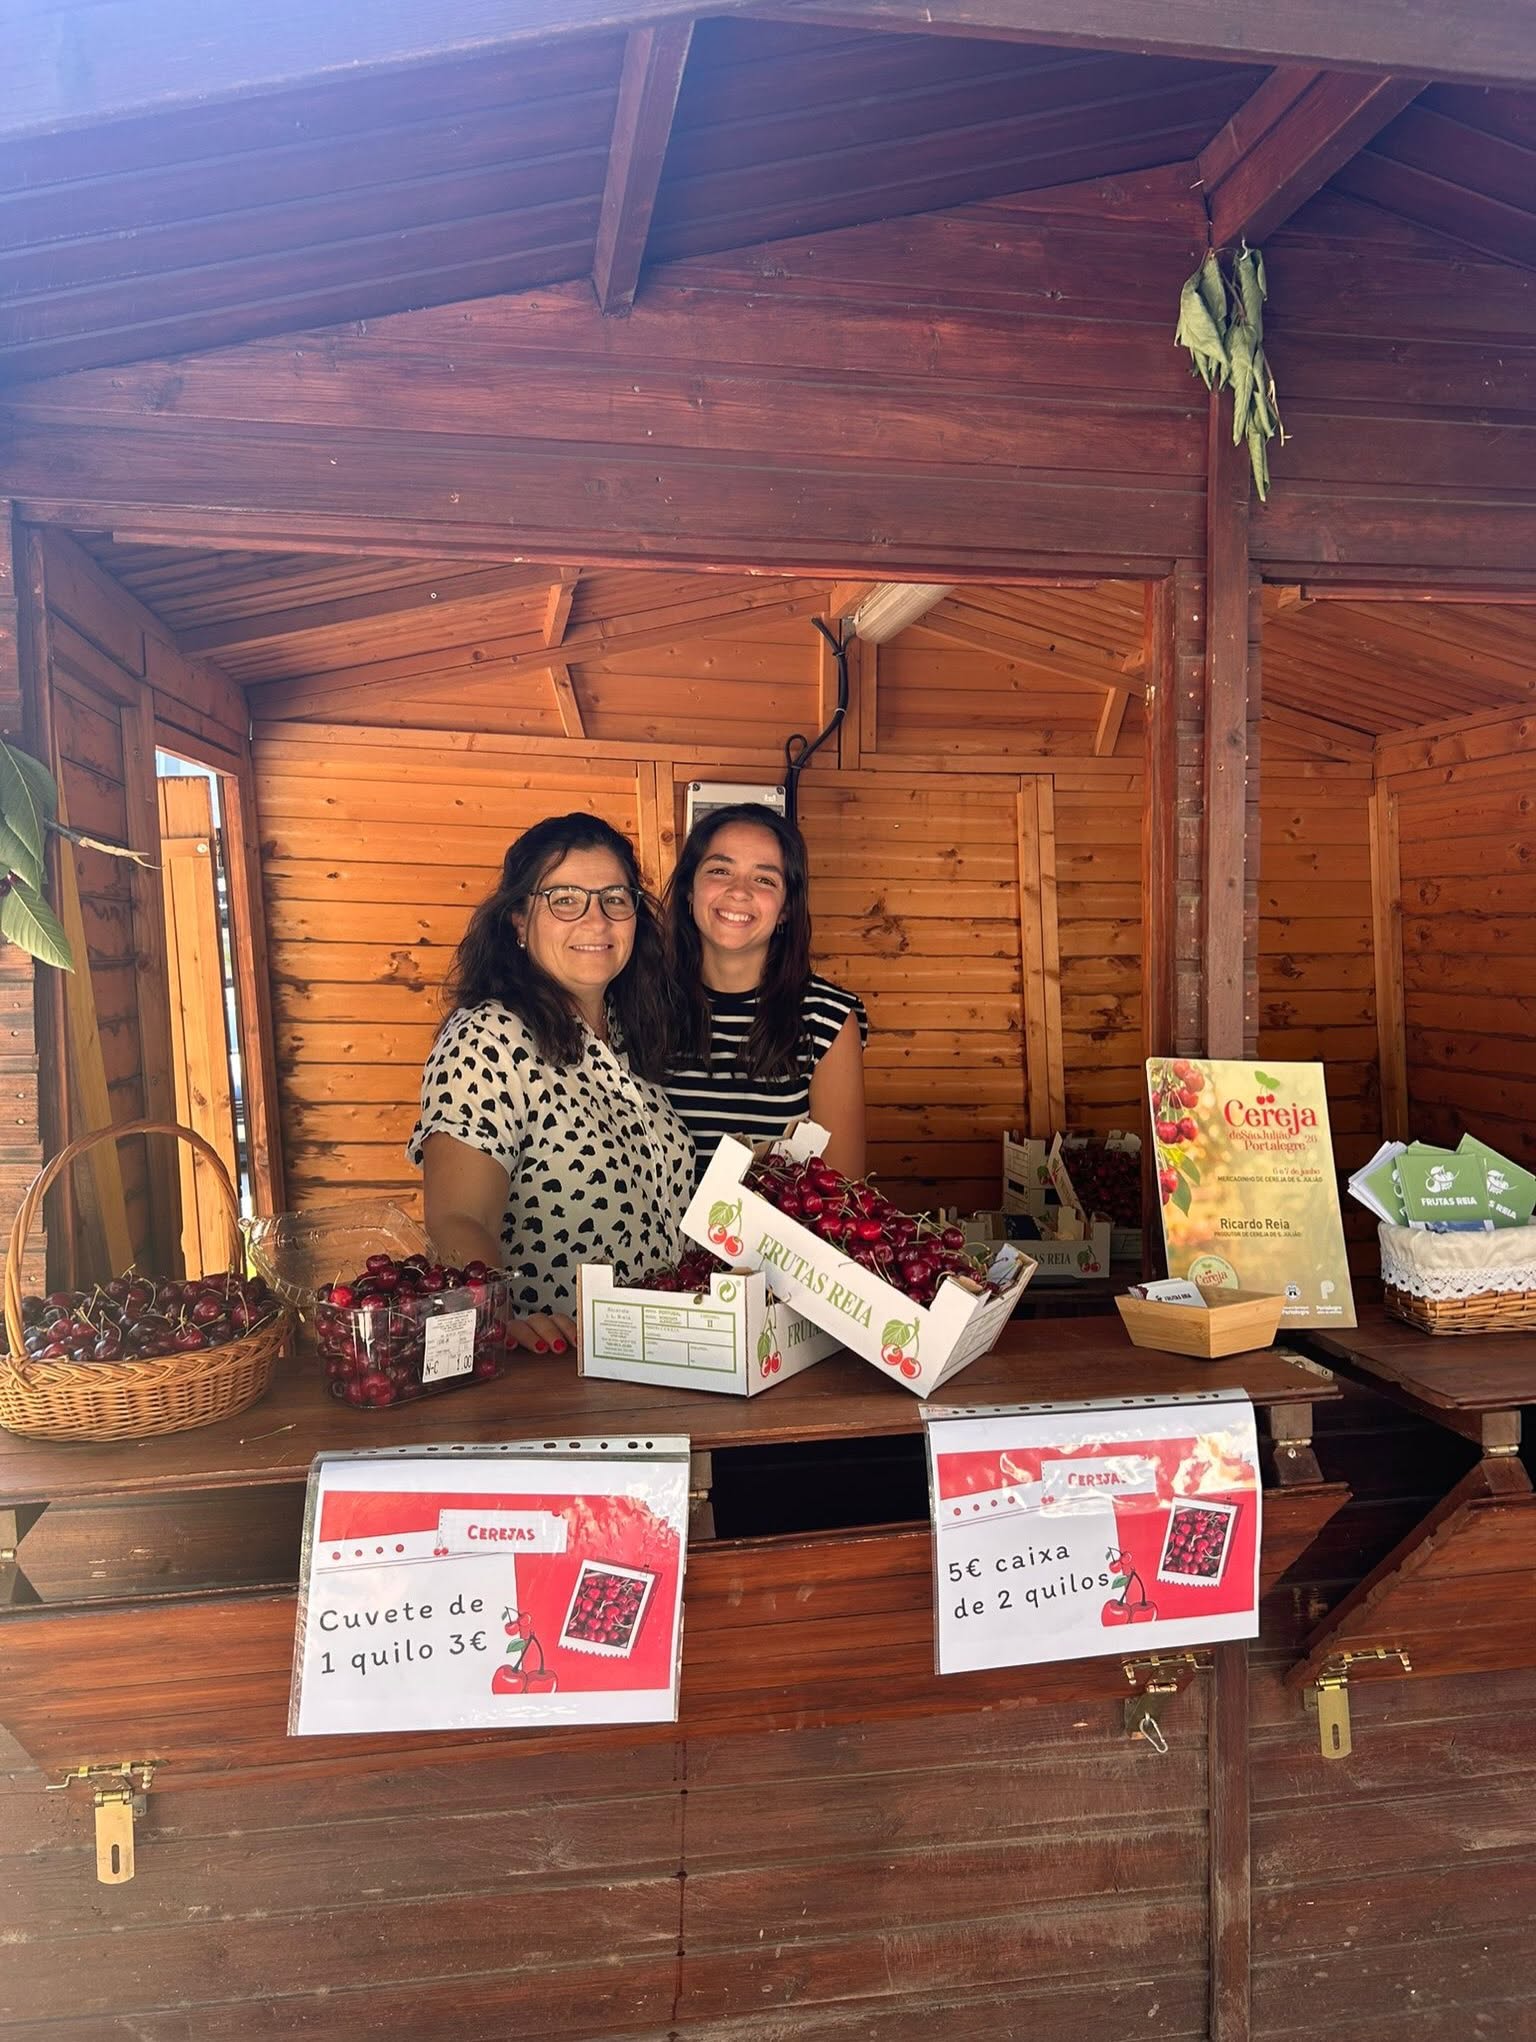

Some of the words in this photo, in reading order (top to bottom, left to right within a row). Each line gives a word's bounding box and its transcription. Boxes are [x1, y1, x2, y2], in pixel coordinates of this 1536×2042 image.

[1224, 1099, 1318, 1136] Cereja
[1244, 1140, 1306, 1153] Portalegre
[1421, 1197, 1456, 1206] FRUTAS
[1457, 1197, 1477, 1206] REIA
[1496, 1204, 1517, 1220] REIA
[1220, 1218, 1263, 1230] Ricardo
[1266, 1219, 1290, 1230] Reia
[1047, 1253, 1071, 1264] REIA
[757, 1232, 829, 1294] FRUTAS
[826, 1281, 873, 1329] REIA
[467, 1524, 536, 1542] CEREJAS
[948, 1558, 982, 1582] 5€
[995, 1545, 1070, 1573] caixa
[954, 1597, 985, 1619] de
[998, 1590, 1012, 1610] 2
[1025, 1573, 1109, 1609] quilos
[319, 1602, 433, 1632] Cuvete
[449, 1593, 484, 1616] de
[320, 1652, 336, 1675] 1
[351, 1639, 433, 1676] quilo
[449, 1630, 488, 1656] 3€
